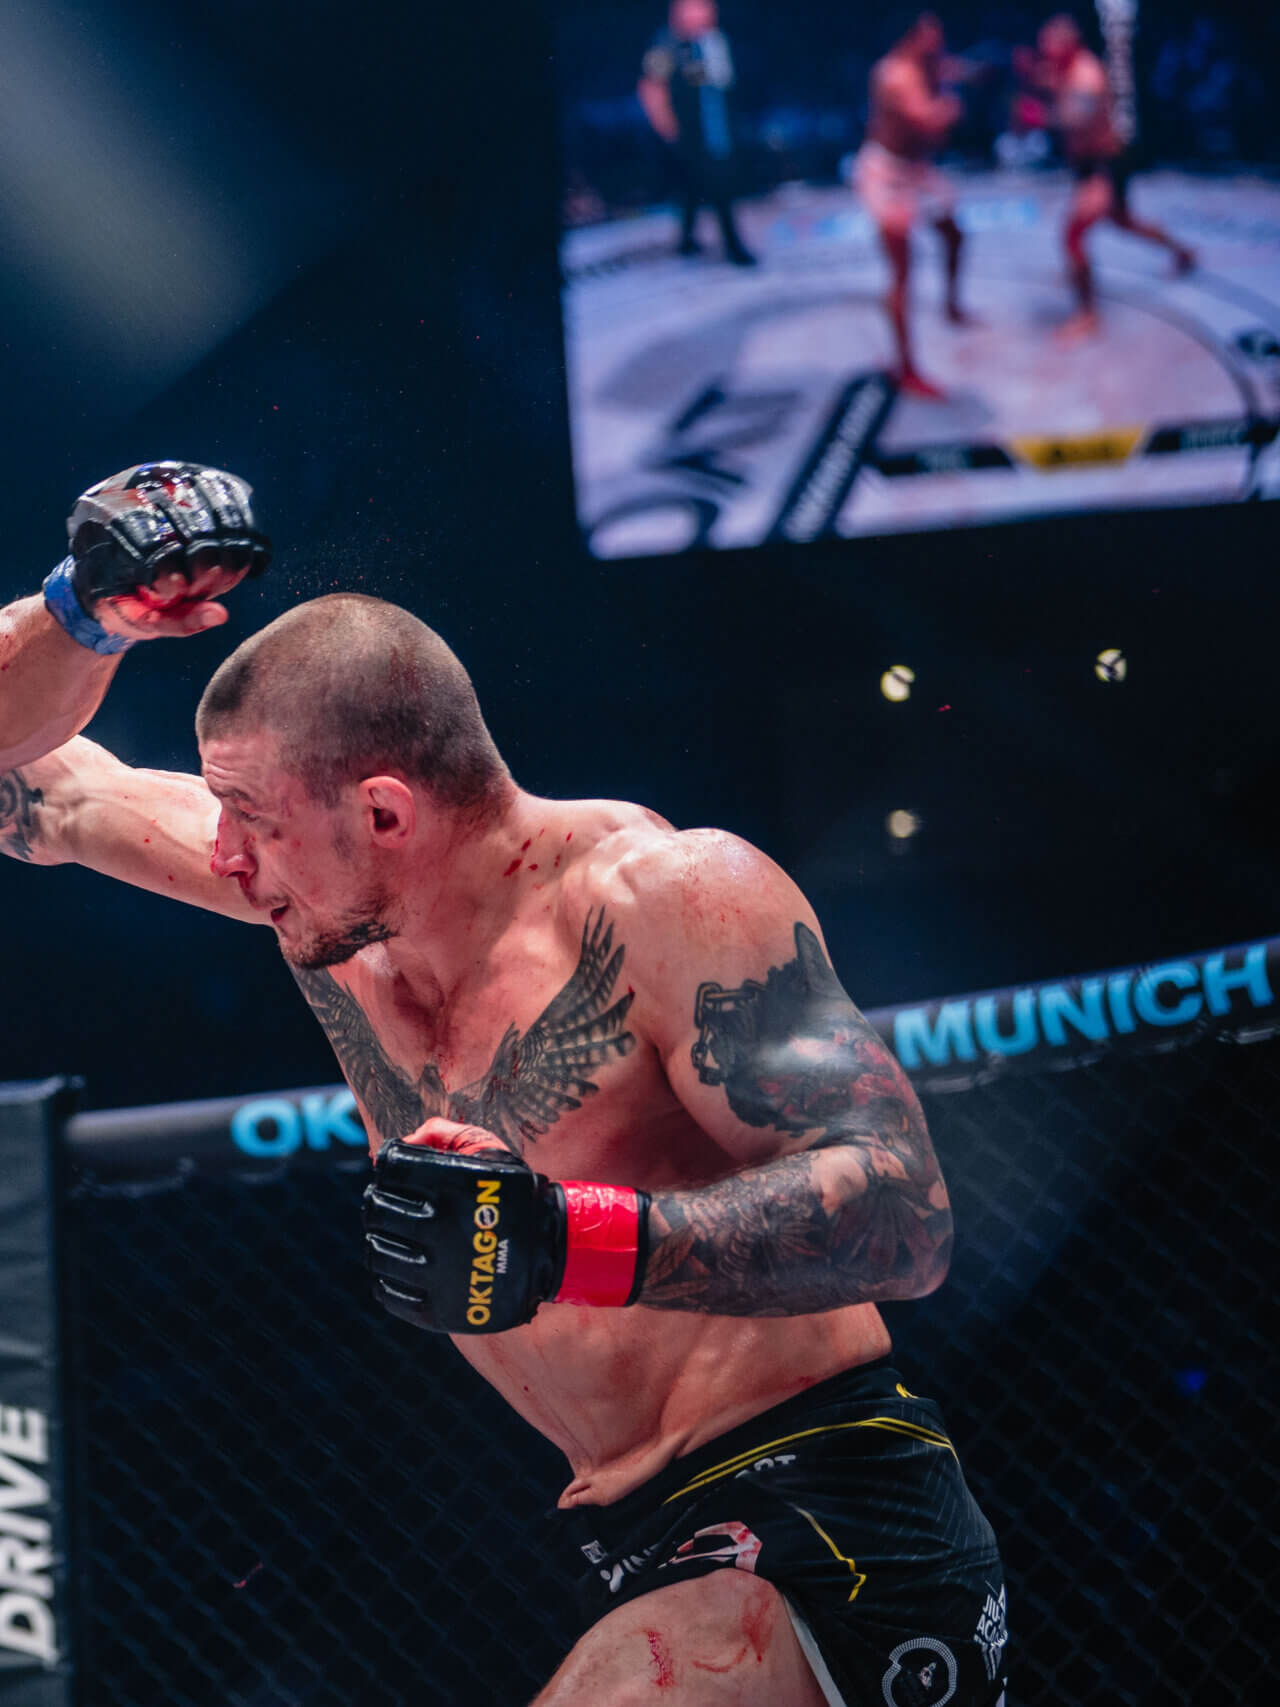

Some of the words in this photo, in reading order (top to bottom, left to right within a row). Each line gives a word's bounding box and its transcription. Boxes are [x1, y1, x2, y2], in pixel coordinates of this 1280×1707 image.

[893, 943, 1273, 1070] MUNICH
[466, 1179, 502, 1326] OKTAGON
[495, 1238, 509, 1274] MMA
